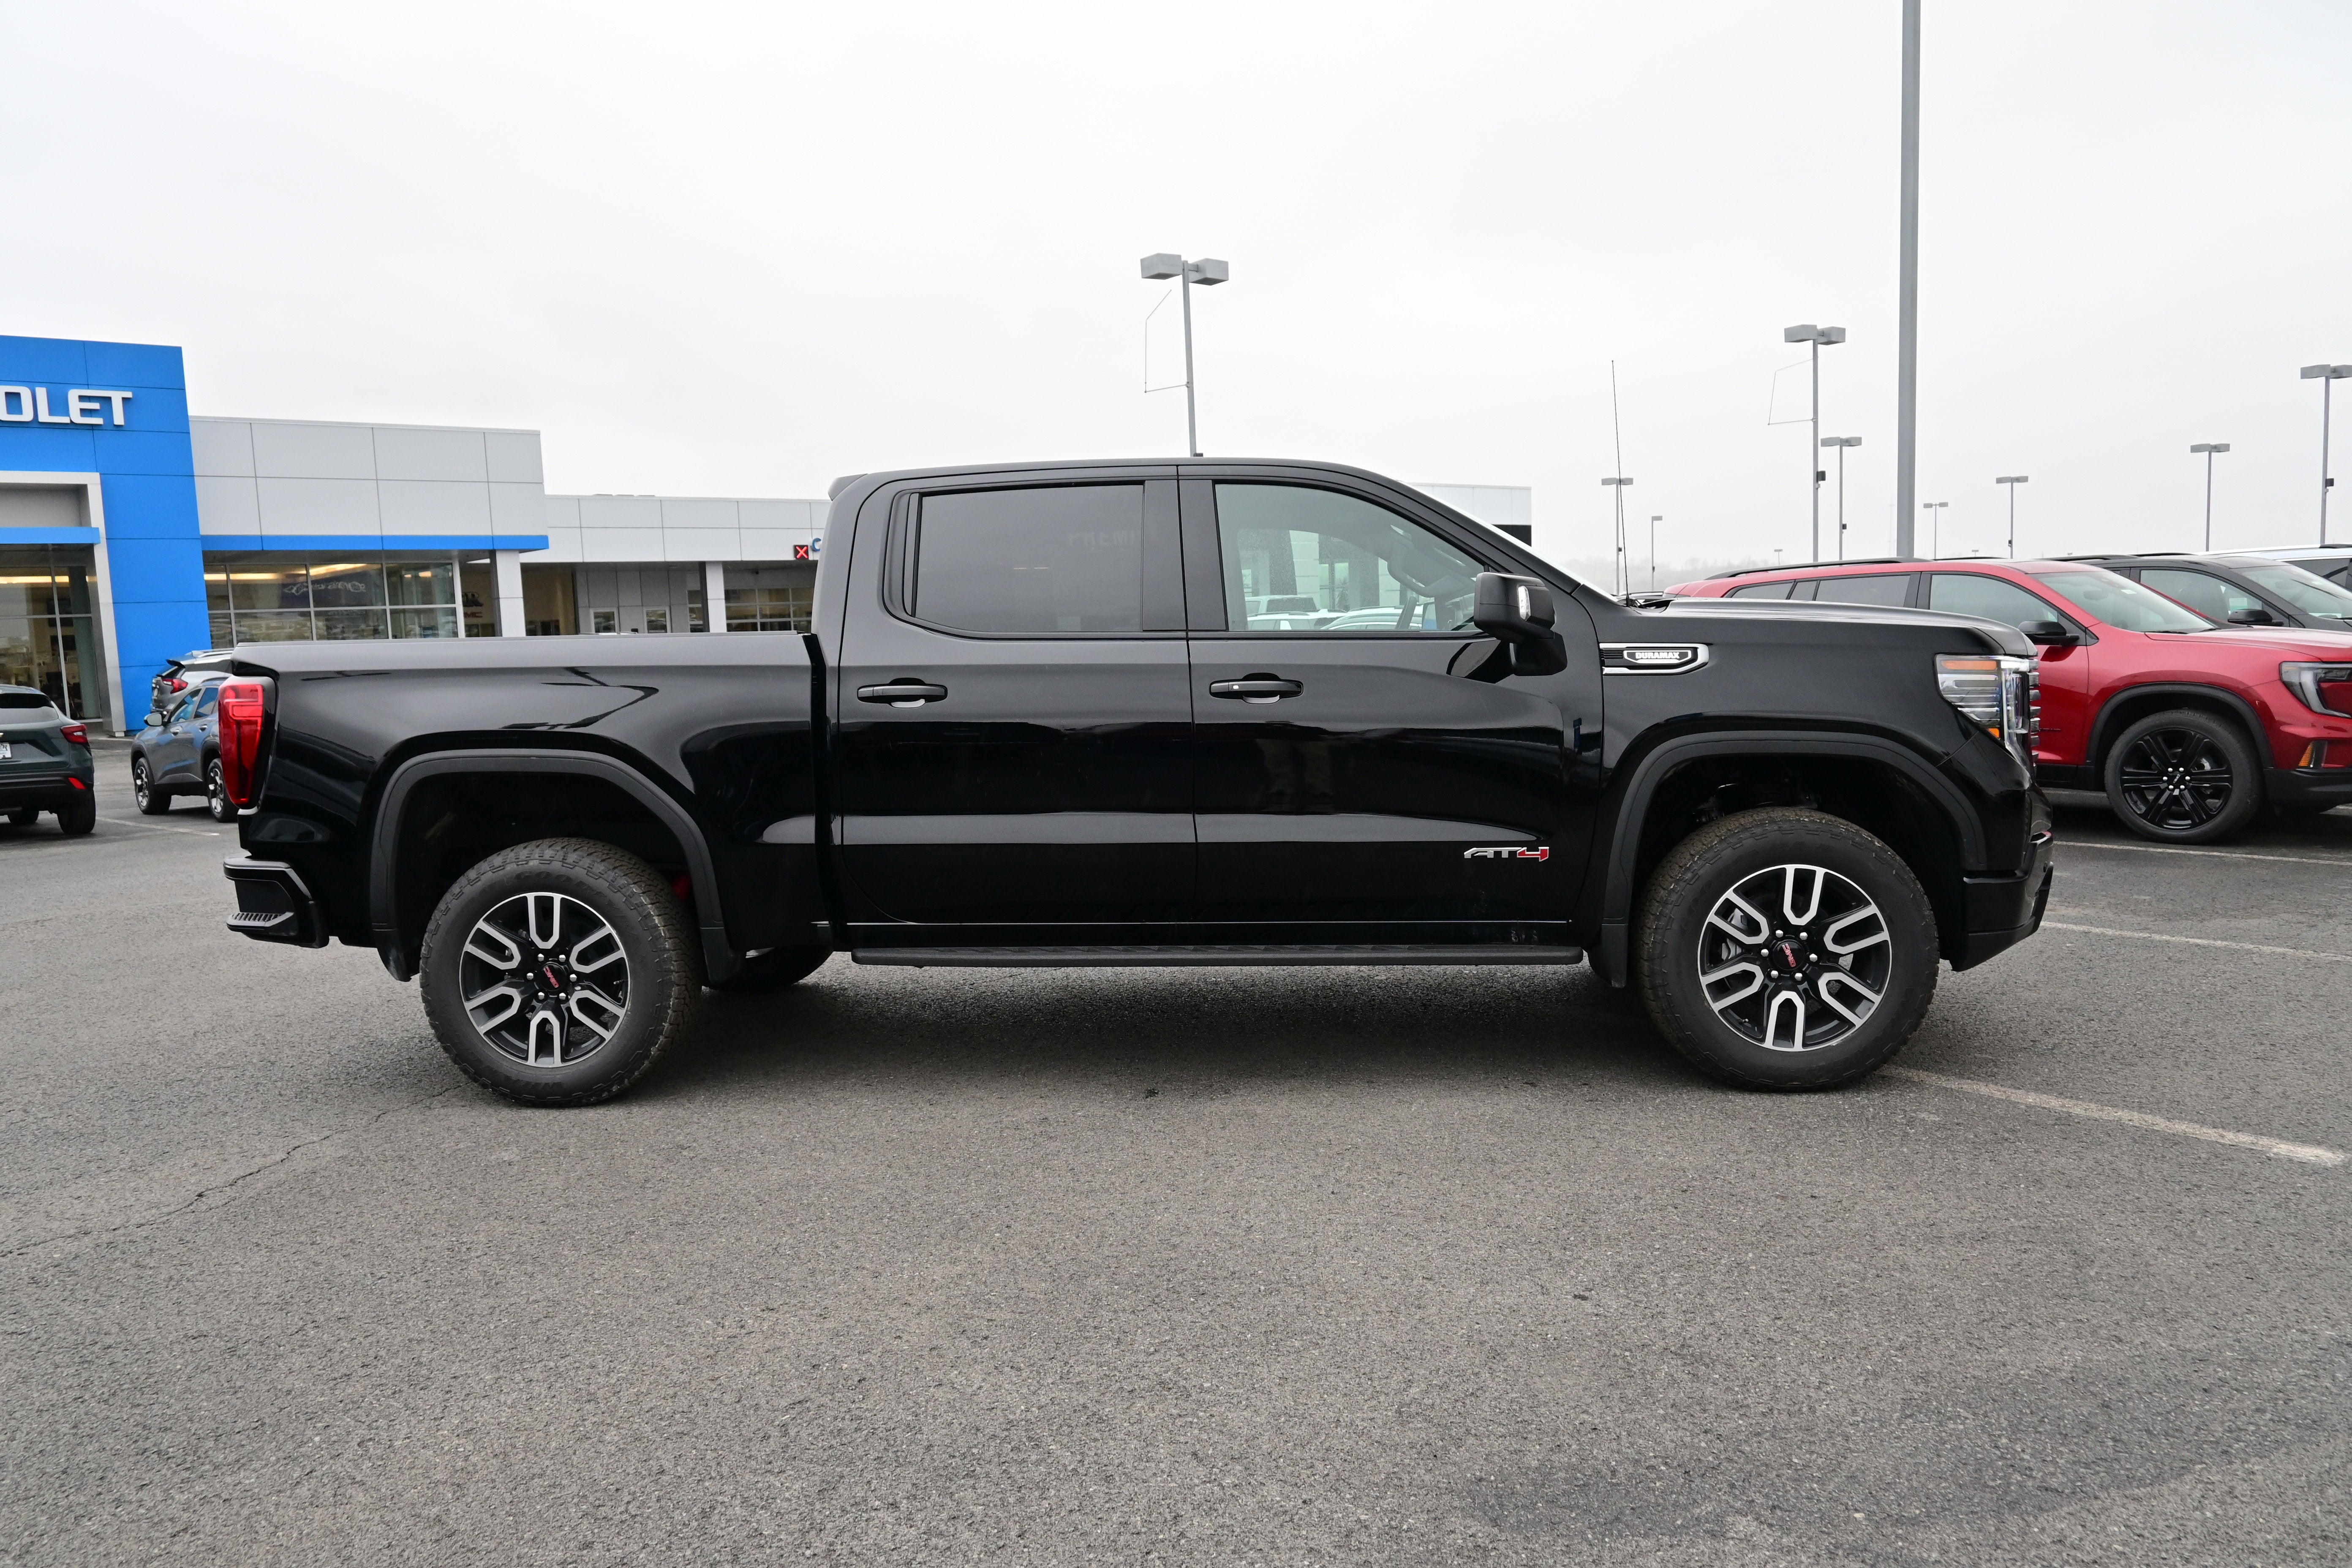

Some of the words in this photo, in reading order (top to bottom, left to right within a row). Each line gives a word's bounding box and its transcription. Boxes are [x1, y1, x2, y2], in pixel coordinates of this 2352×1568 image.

[0, 385, 133, 426] OLET
[1464, 846, 1549, 862] AT4
[1782, 943, 1796, 967] GMC
[543, 966, 559, 988] GMC
